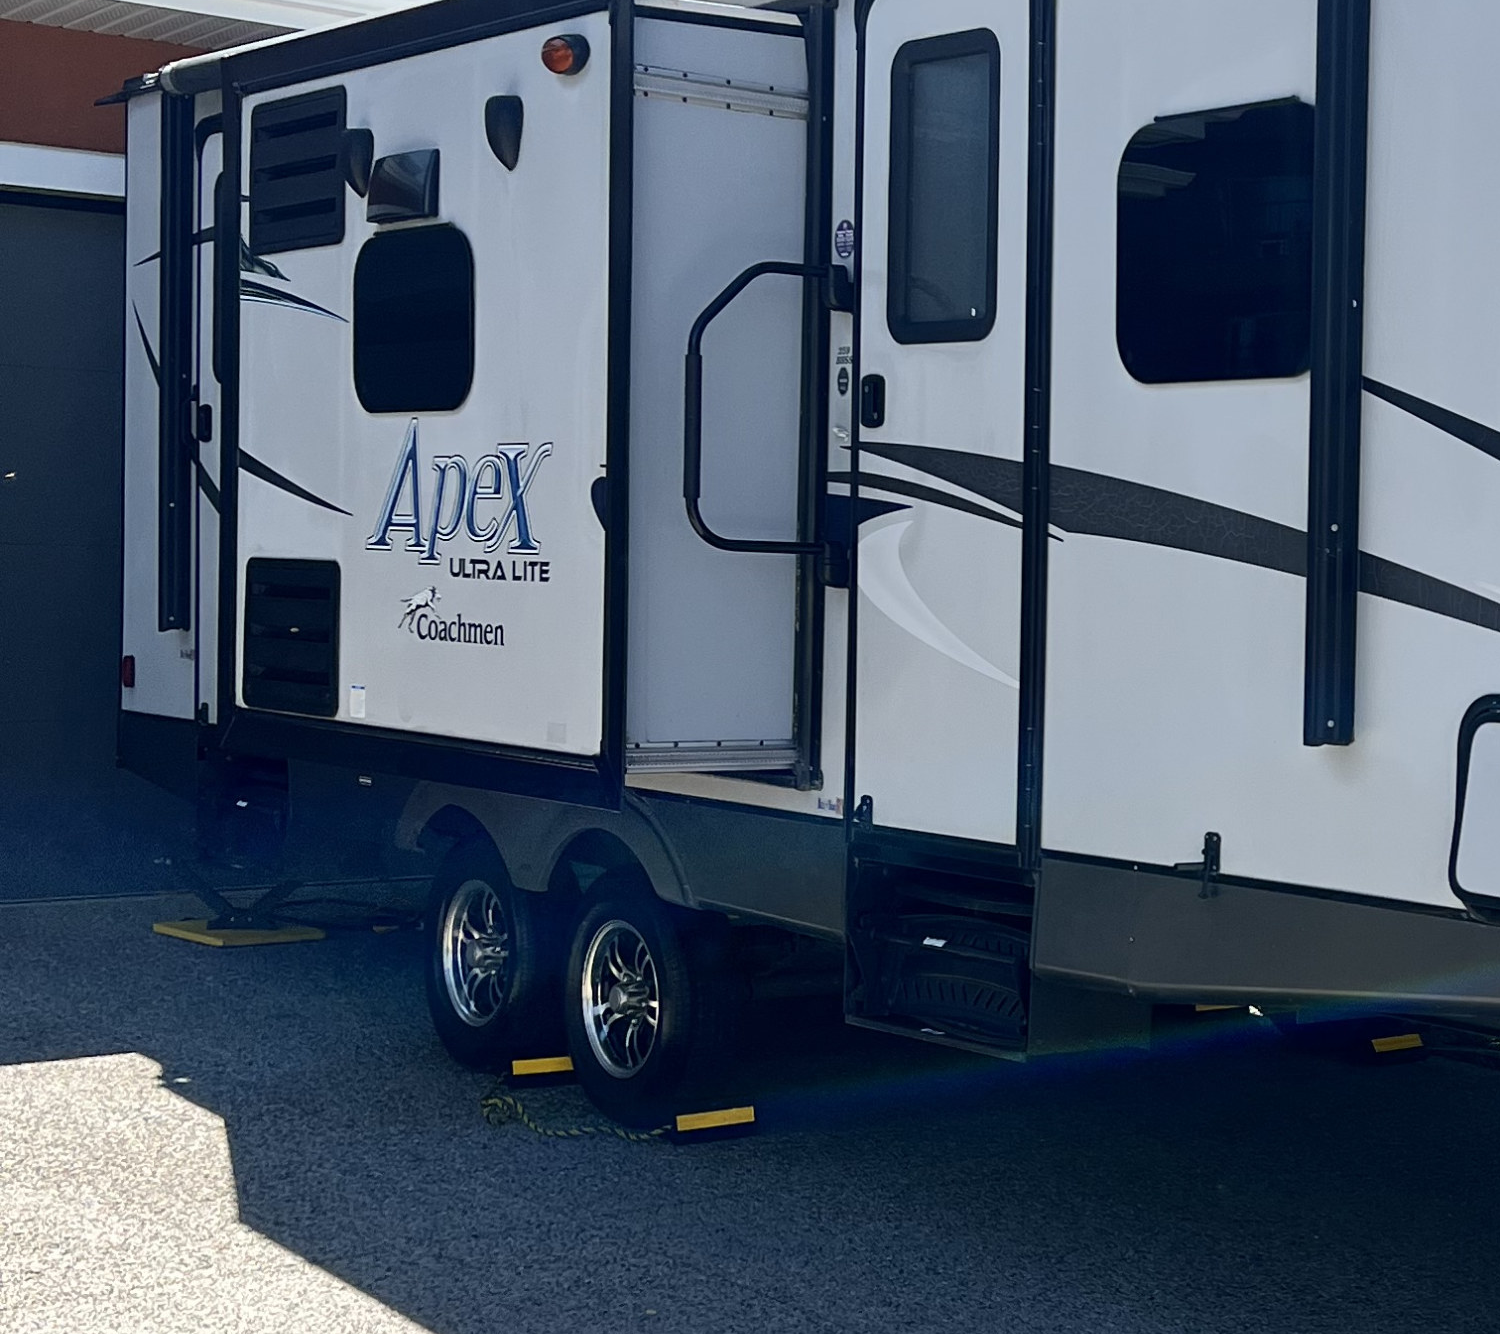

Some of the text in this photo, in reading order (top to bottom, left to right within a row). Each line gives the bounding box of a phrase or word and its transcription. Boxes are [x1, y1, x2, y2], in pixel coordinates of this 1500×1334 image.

[365, 417, 553, 565] Apex
[449, 557, 551, 583] ULTRA LITE
[416, 613, 505, 647] Coachmen
